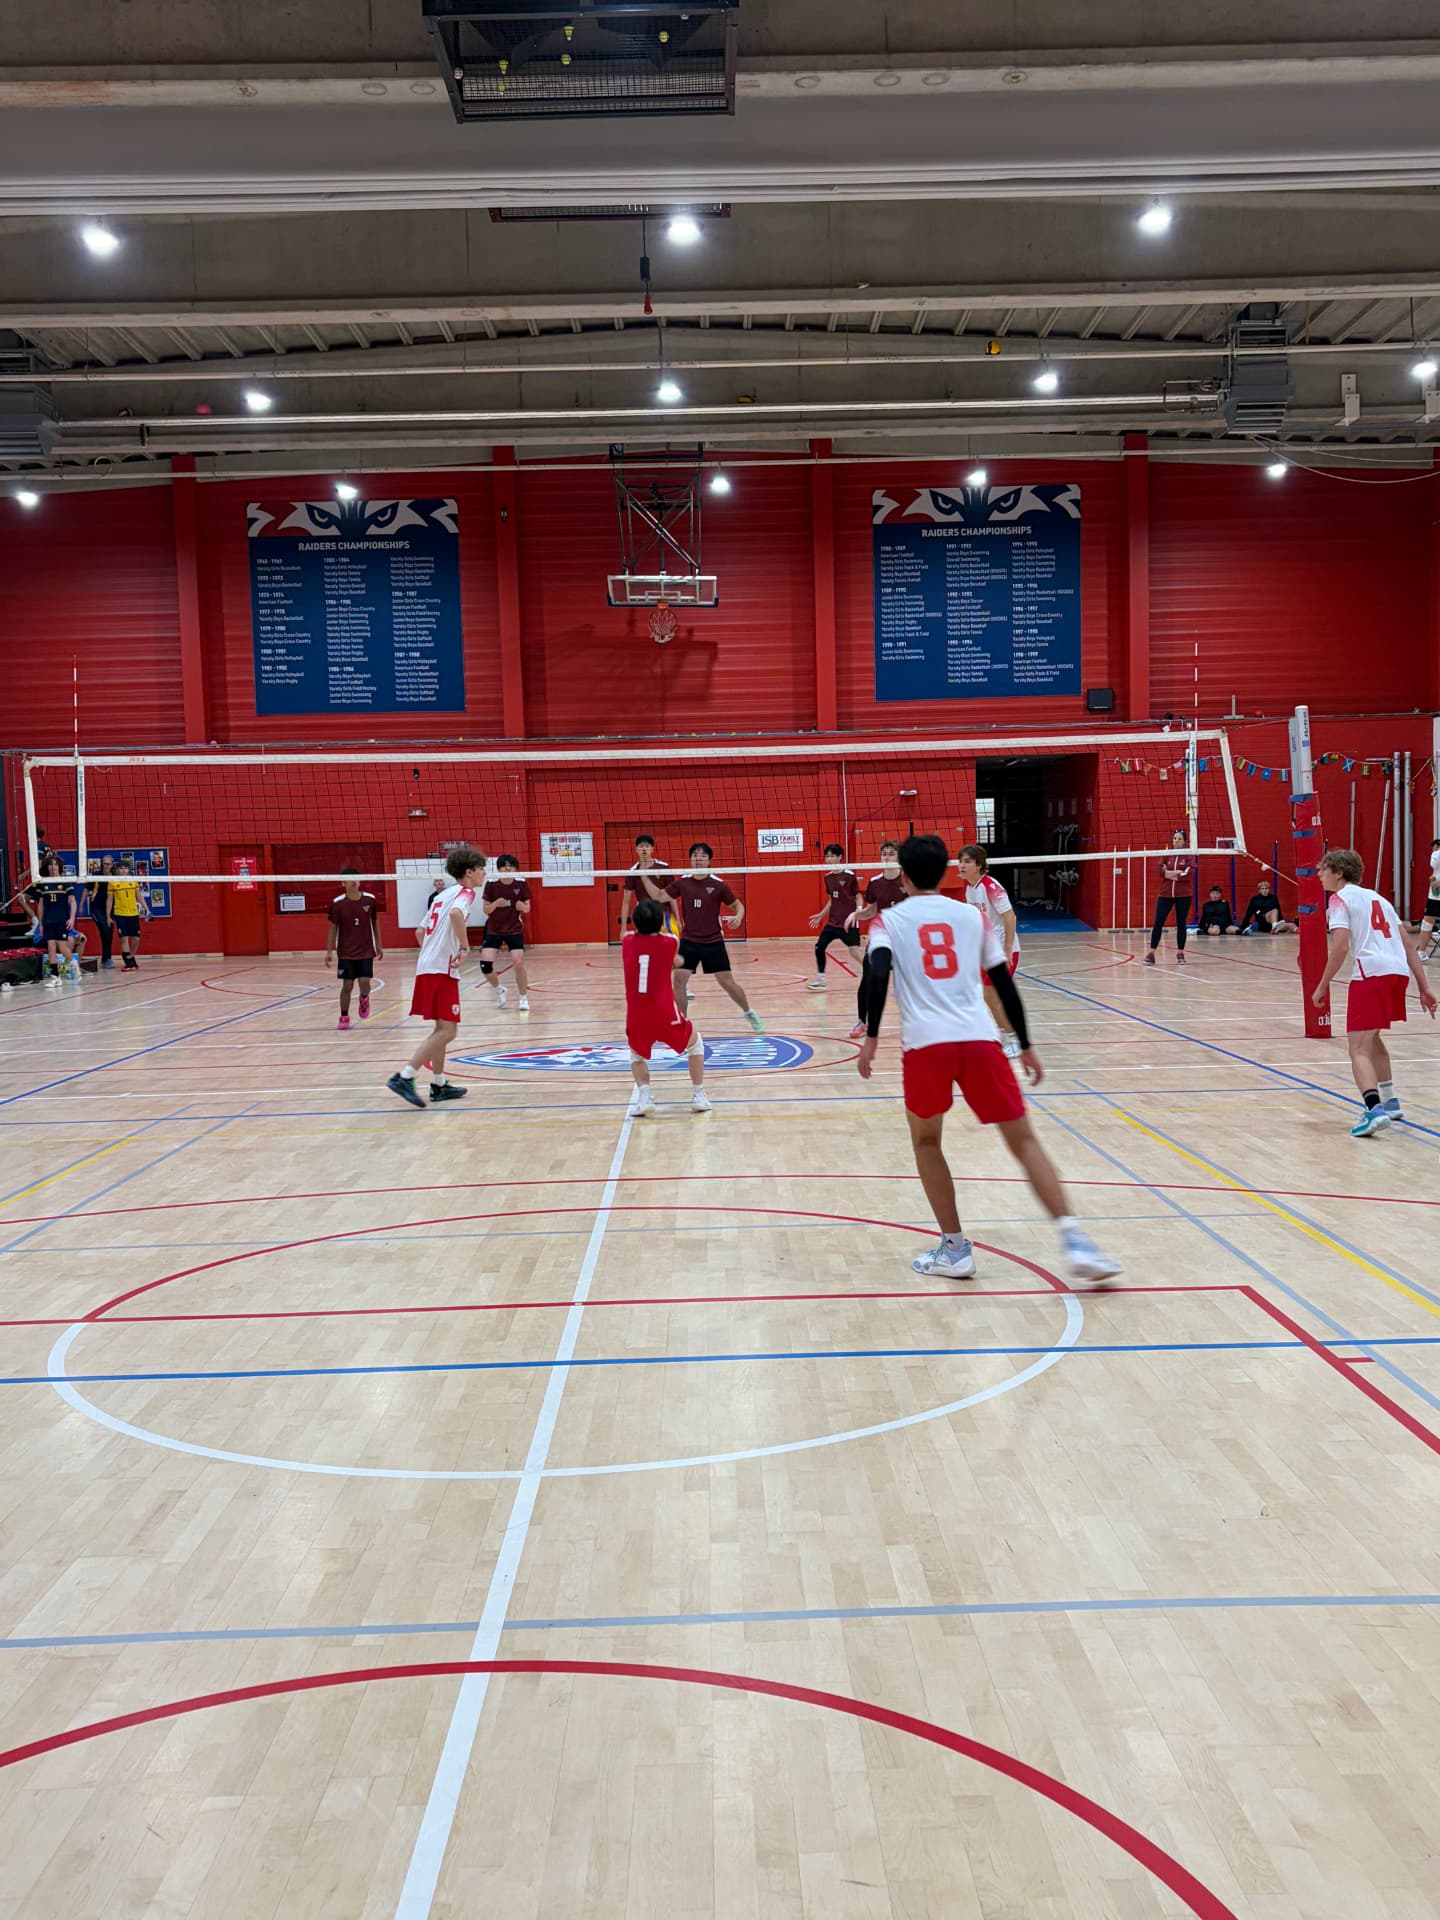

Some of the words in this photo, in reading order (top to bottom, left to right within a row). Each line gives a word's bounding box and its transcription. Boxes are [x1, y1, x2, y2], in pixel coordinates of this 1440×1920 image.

[921, 528, 960, 537] RAIDERS
[960, 526, 1032, 536] CHAMPIONSHIPS
[298, 542, 337, 551] RAIDERS
[337, 541, 411, 550] CHAMPIONSHIPS
[761, 835, 779, 845] ISB
[694, 899, 702, 908] 10
[425, 901, 443, 936] 5
[1370, 900, 1392, 939] 4
[917, 922, 959, 980] 8
[638, 954, 650, 993] 1
